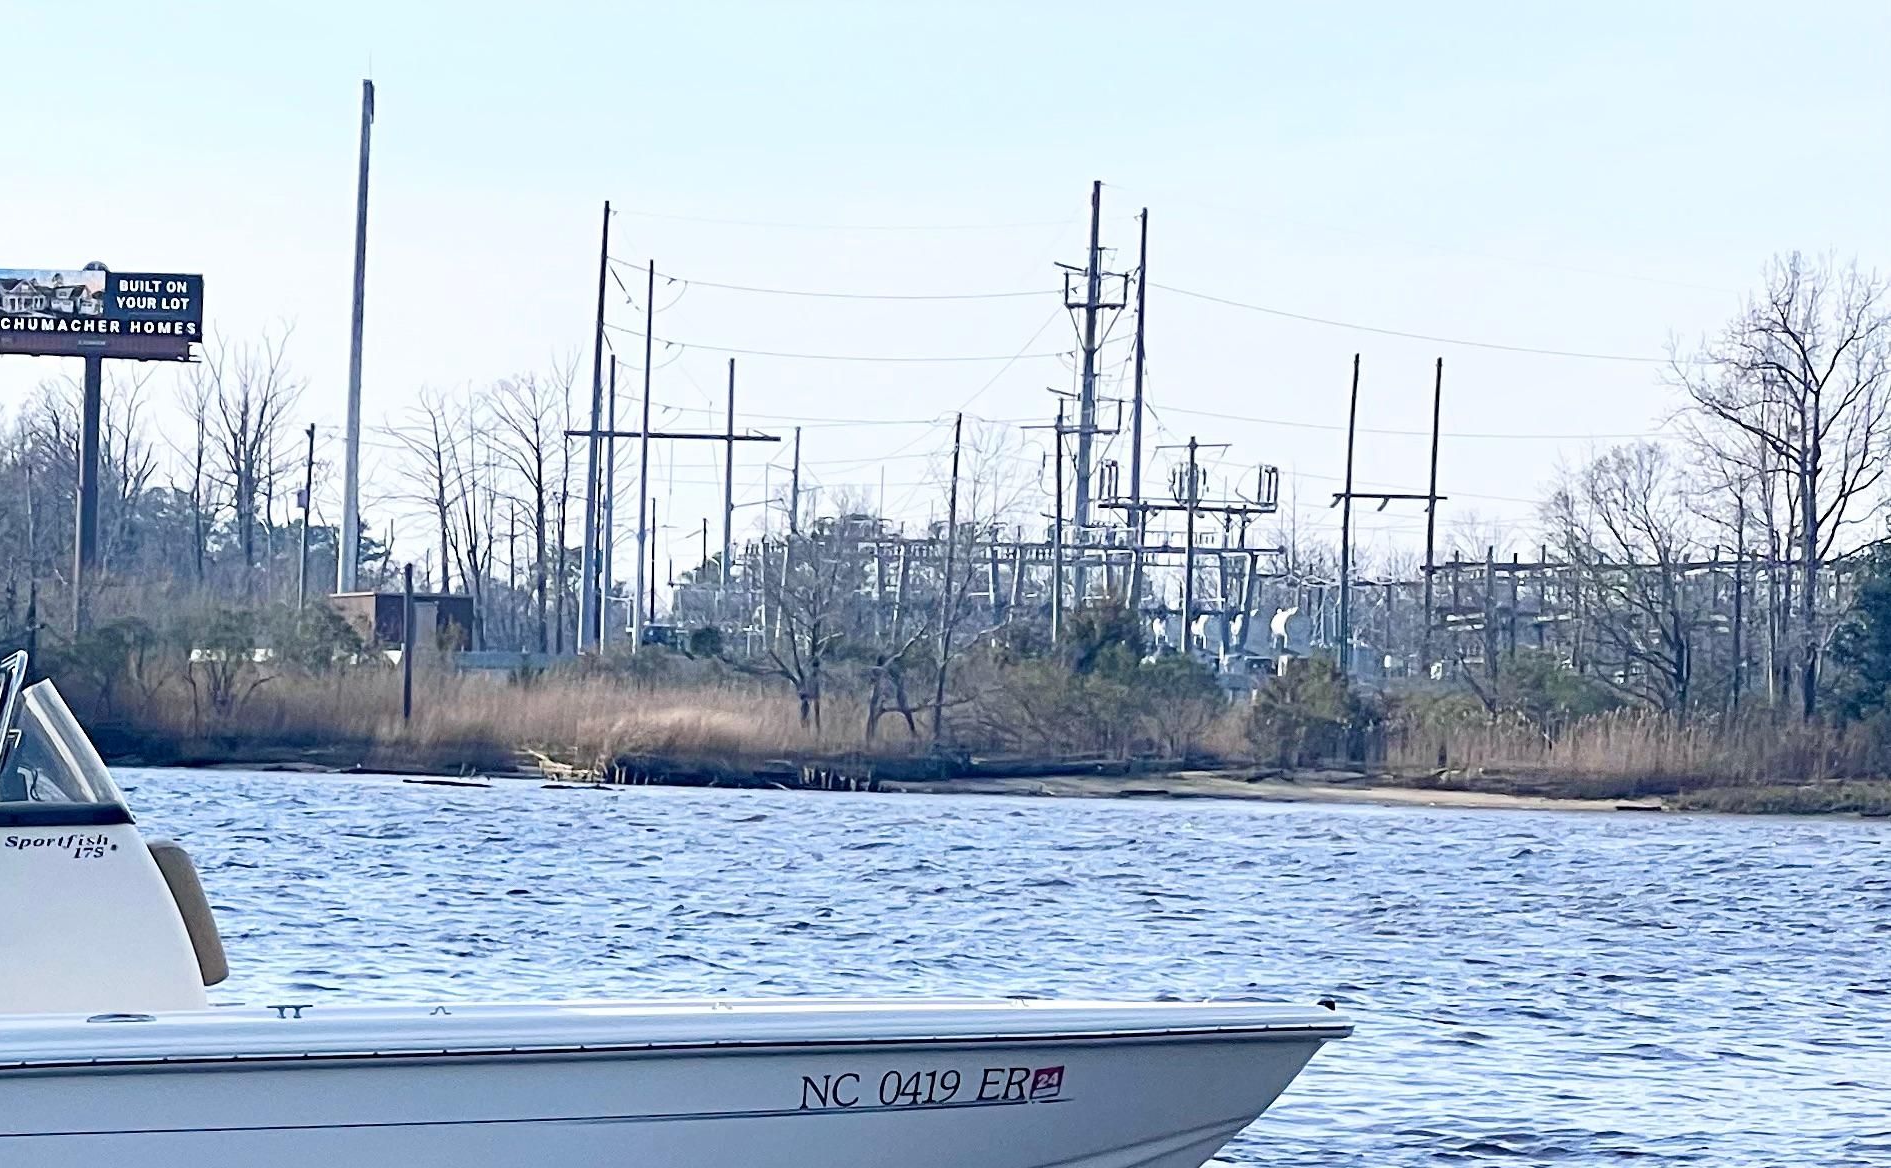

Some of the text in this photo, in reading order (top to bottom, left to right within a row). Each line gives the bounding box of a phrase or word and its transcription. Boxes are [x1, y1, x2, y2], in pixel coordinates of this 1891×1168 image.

[119, 279, 187, 293] BUILT ON
[116, 296, 190, 310] YOUR LOT
[130, 320, 196, 335] HOMES
[4, 834, 109, 850] Sportfish
[1036, 1072, 1059, 1089] 24
[799, 1067, 1031, 1110] NC 0419 ER
